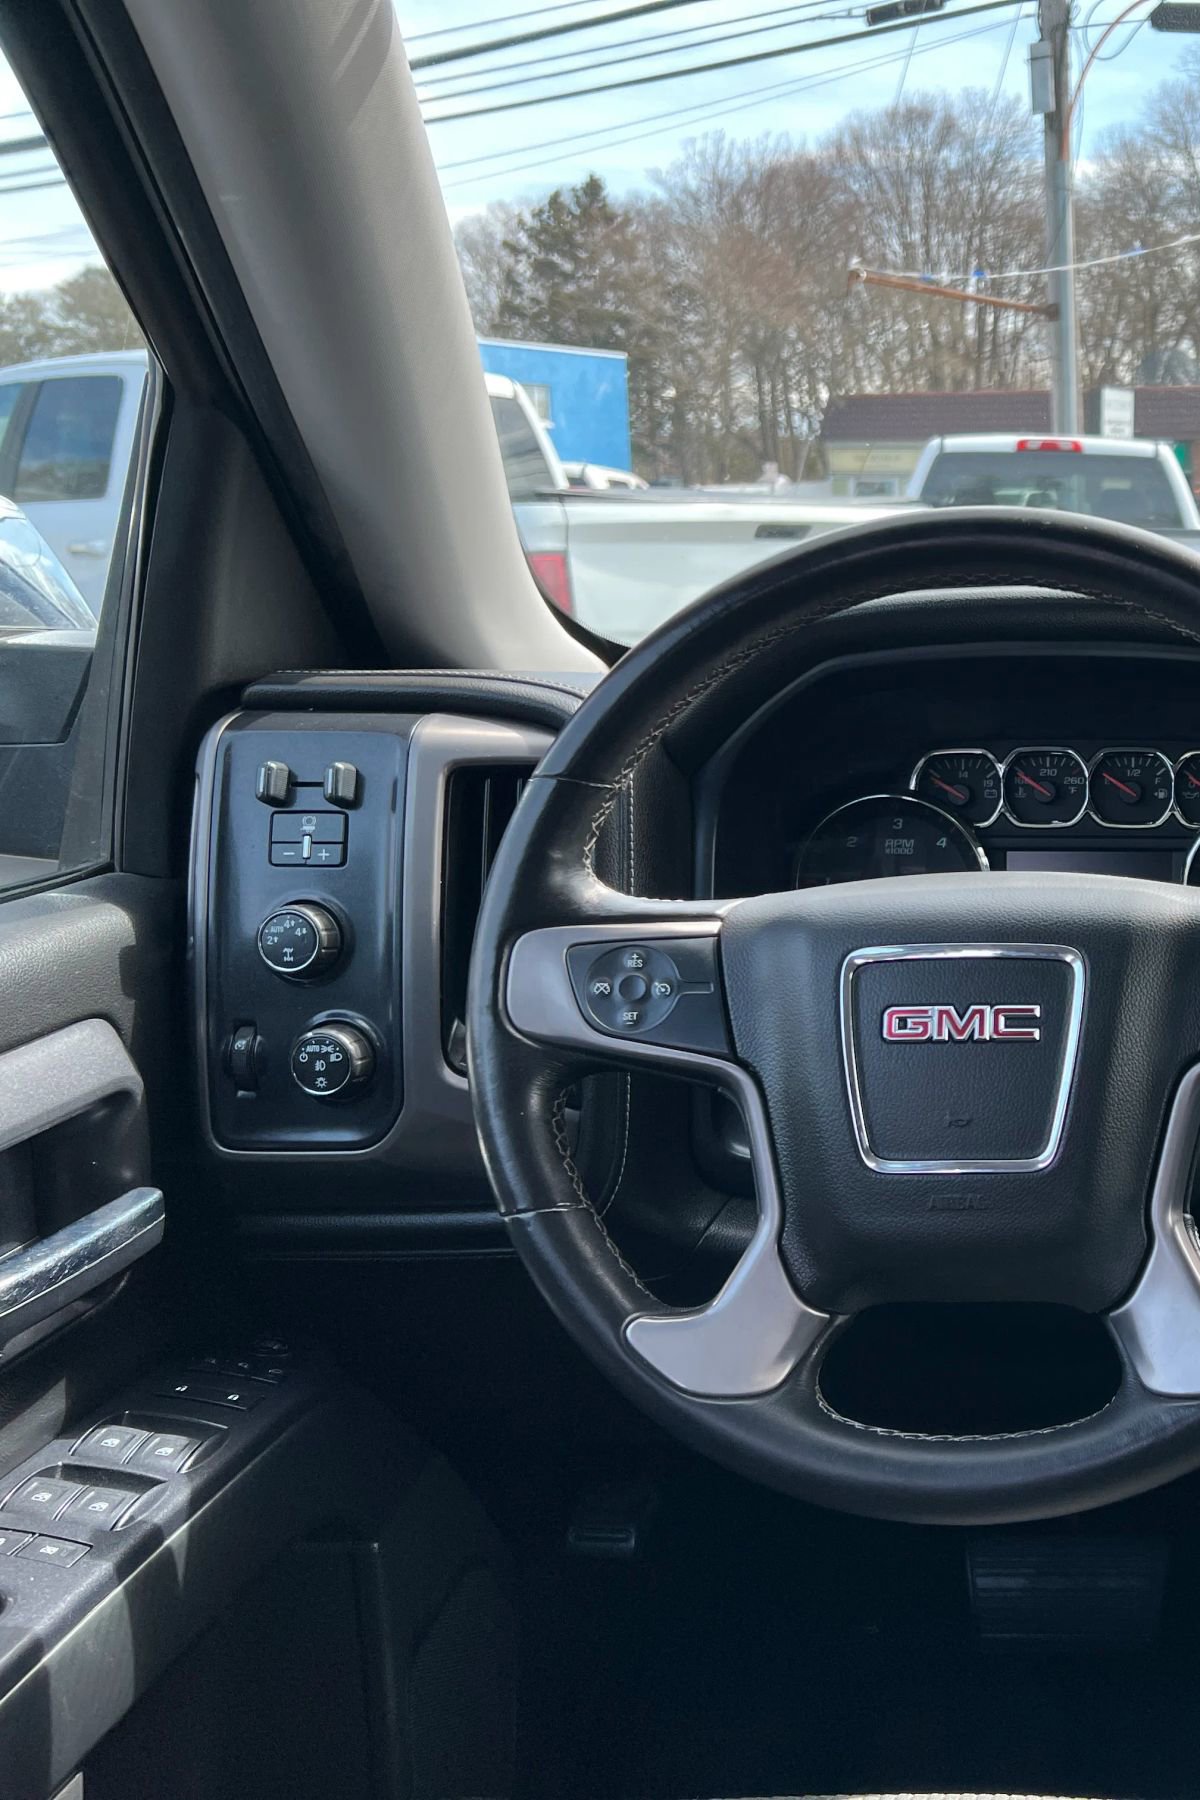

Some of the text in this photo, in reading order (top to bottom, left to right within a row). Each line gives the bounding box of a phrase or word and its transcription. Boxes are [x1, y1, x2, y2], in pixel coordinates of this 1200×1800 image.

[958, 771, 969, 779] 14
[1039, 769, 1057, 777] 210
[1127, 769, 1141, 777] 1/2
[983, 779, 993, 788] 19
[1064, 777, 1085, 785] 260
[1154, 777, 1161, 785] F
[892, 819, 903, 830] 3
[846, 836, 858, 848] 2
[885, 839, 914, 848] RPM
[936, 837, 947, 848] 4
[627, 960, 643, 968] RES
[622, 1011, 639, 1020] SET
[882, 1005, 1041, 1041] GMC
[306, 1044, 320, 1053] AUTO
